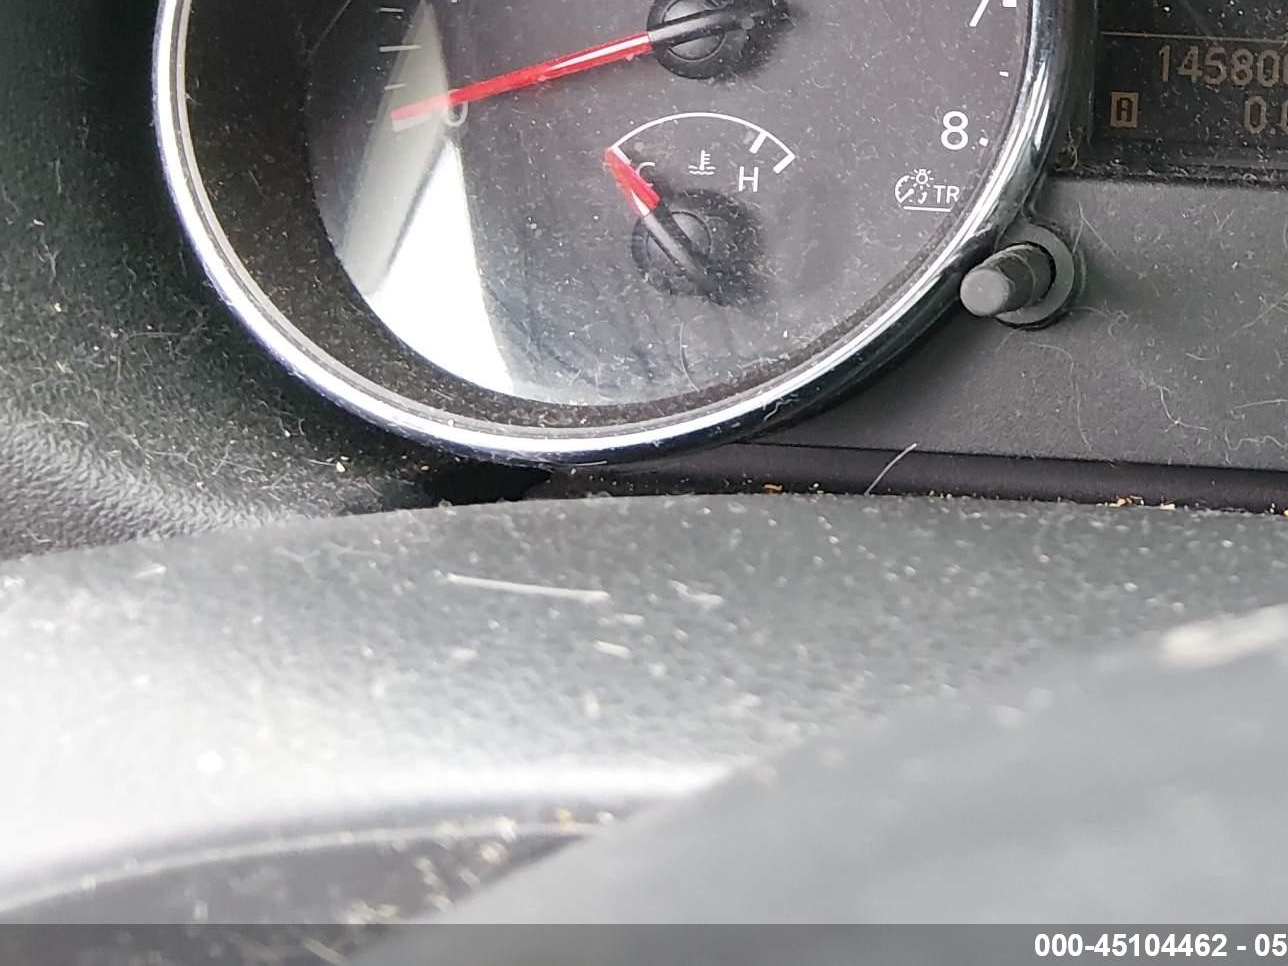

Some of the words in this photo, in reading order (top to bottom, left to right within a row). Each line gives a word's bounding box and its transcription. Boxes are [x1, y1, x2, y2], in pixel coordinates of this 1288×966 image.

[940, 110, 969, 151] 8
[738, 165, 759, 193] H
[932, 184, 960, 204] TR
